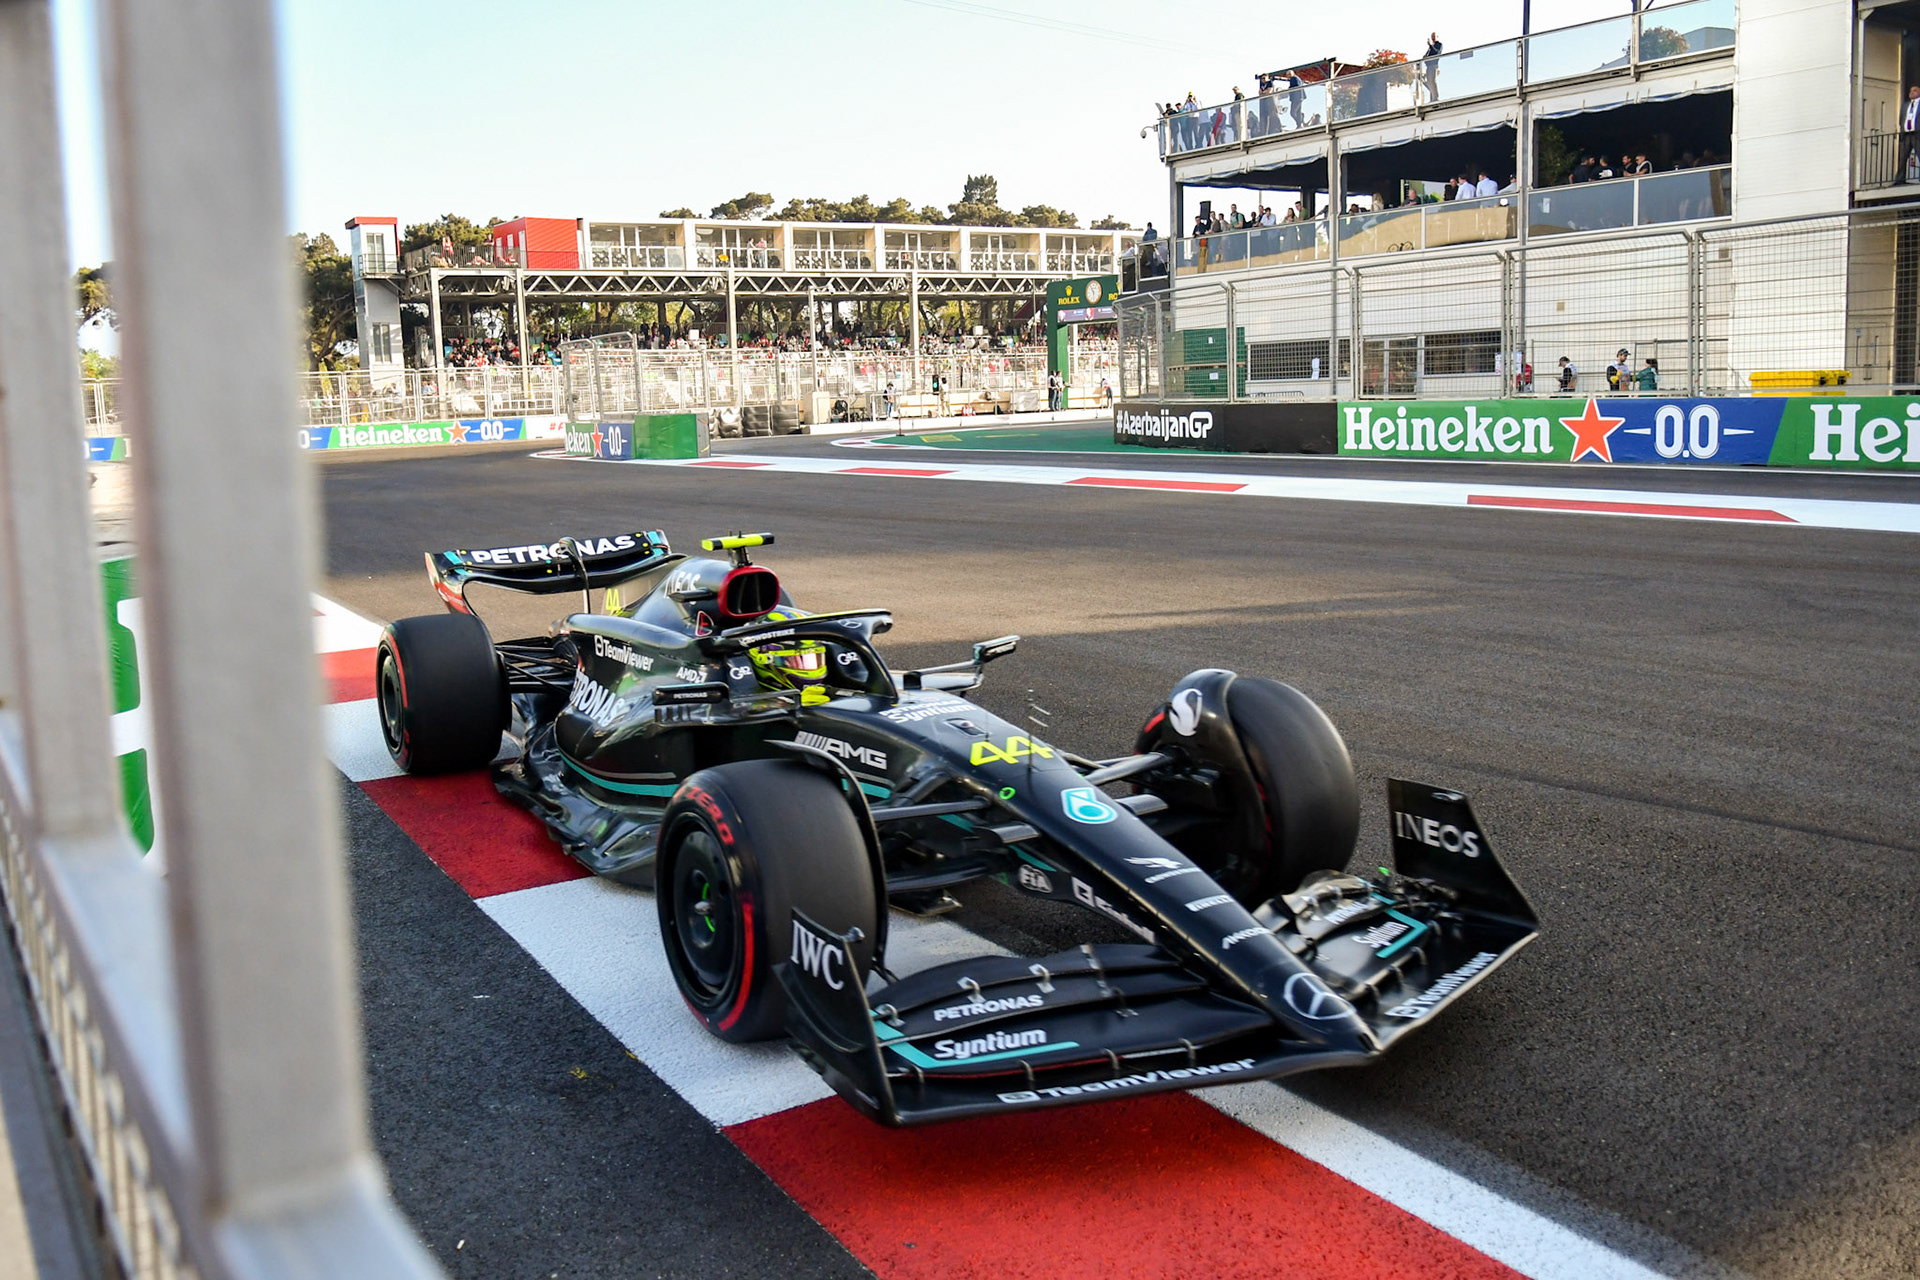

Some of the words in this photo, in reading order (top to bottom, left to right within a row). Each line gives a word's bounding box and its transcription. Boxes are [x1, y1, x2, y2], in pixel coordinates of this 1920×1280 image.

[1058, 296, 1080, 305] ROLEX
[338, 425, 444, 447] Heineken
[565, 425, 591, 453] eken
[1116, 409, 1213, 442] #AzerbaijanGP
[1343, 406, 1554, 454] Heineken
[1655, 405, 1719, 459] 0.0
[471, 535, 636, 564] PETRONAS
[603, 639, 654, 672] TeamViewer
[676, 667, 697, 681] AMD
[569, 668, 626, 727] TRONAS
[673, 691, 708, 699] PETRONAS
[888, 704, 977, 724] Syntium
[824, 739, 888, 770] AMG
[970, 735, 1054, 767] 44
[1395, 812, 1480, 858] INEOS
[1020, 866, 1051, 890] FIA
[791, 919, 845, 991] IWC
[934, 994, 1045, 1022] PETRONAS
[934, 1028, 1048, 1060] Syntium
[1036, 1058, 1257, 1101] TeamViewer
